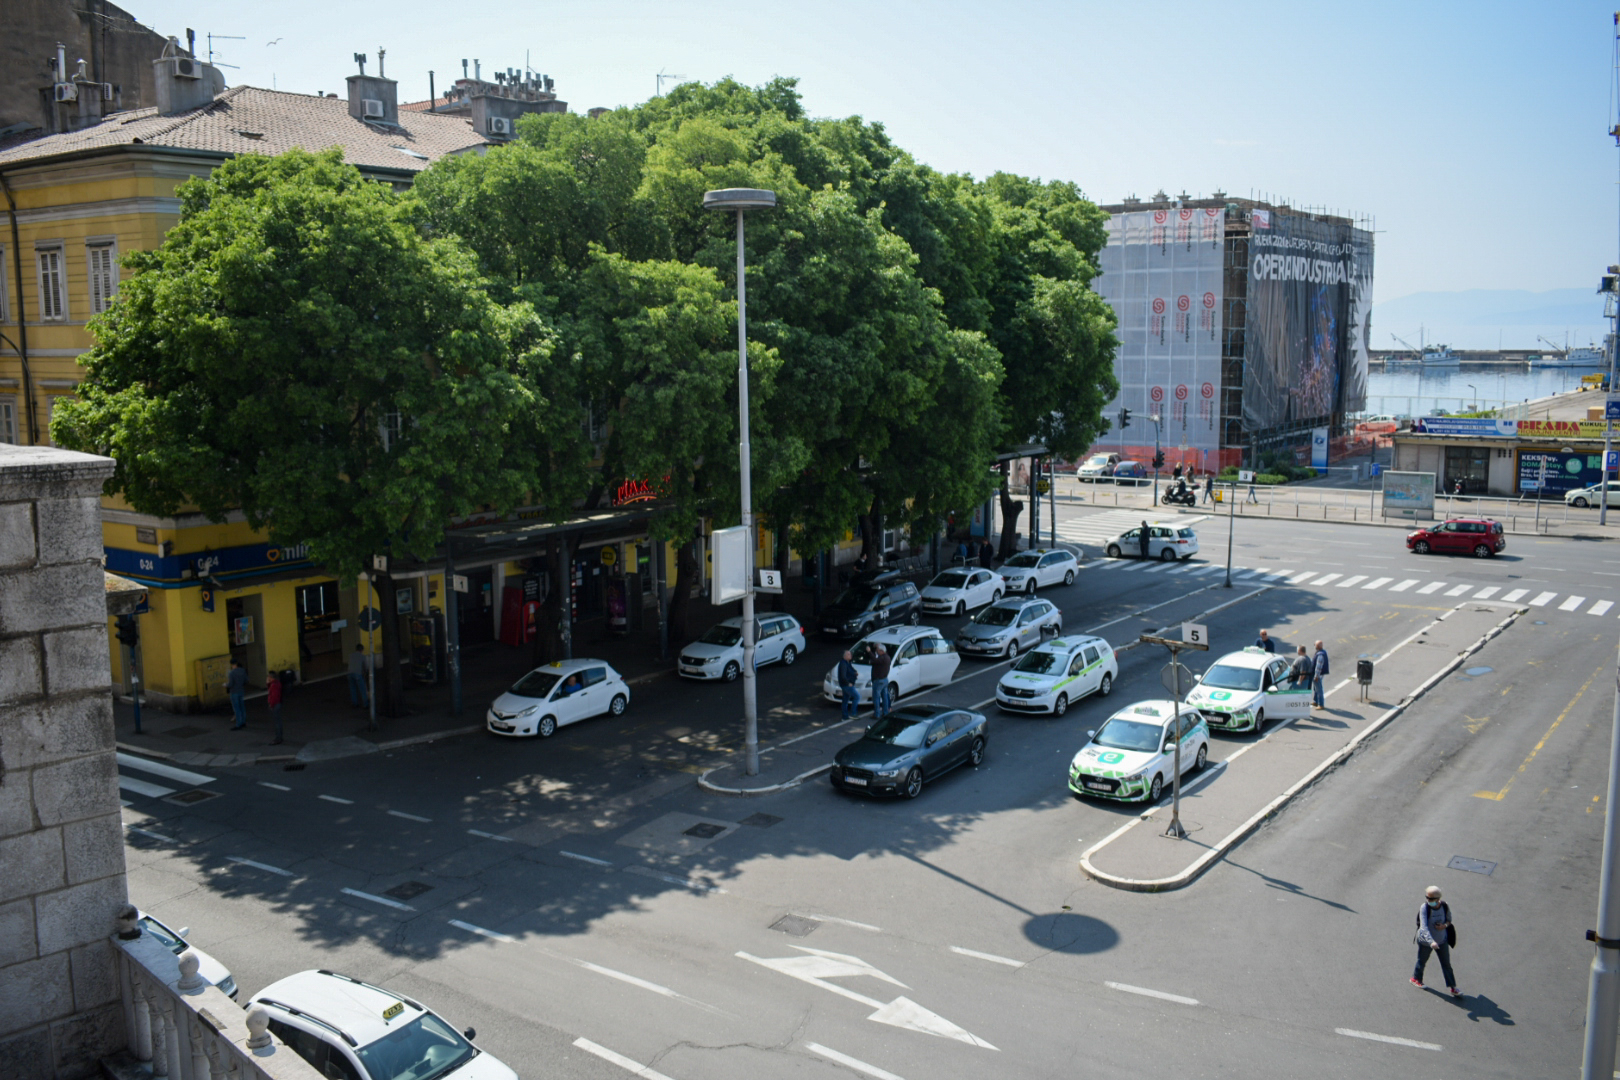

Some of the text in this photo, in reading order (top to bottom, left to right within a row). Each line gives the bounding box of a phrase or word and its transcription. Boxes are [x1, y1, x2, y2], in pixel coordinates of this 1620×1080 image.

[139, 559, 154, 571] 0-24
[197, 555, 219, 569] 024
[767, 575, 774, 585] 3
[1191, 630, 1199, 641] 5
